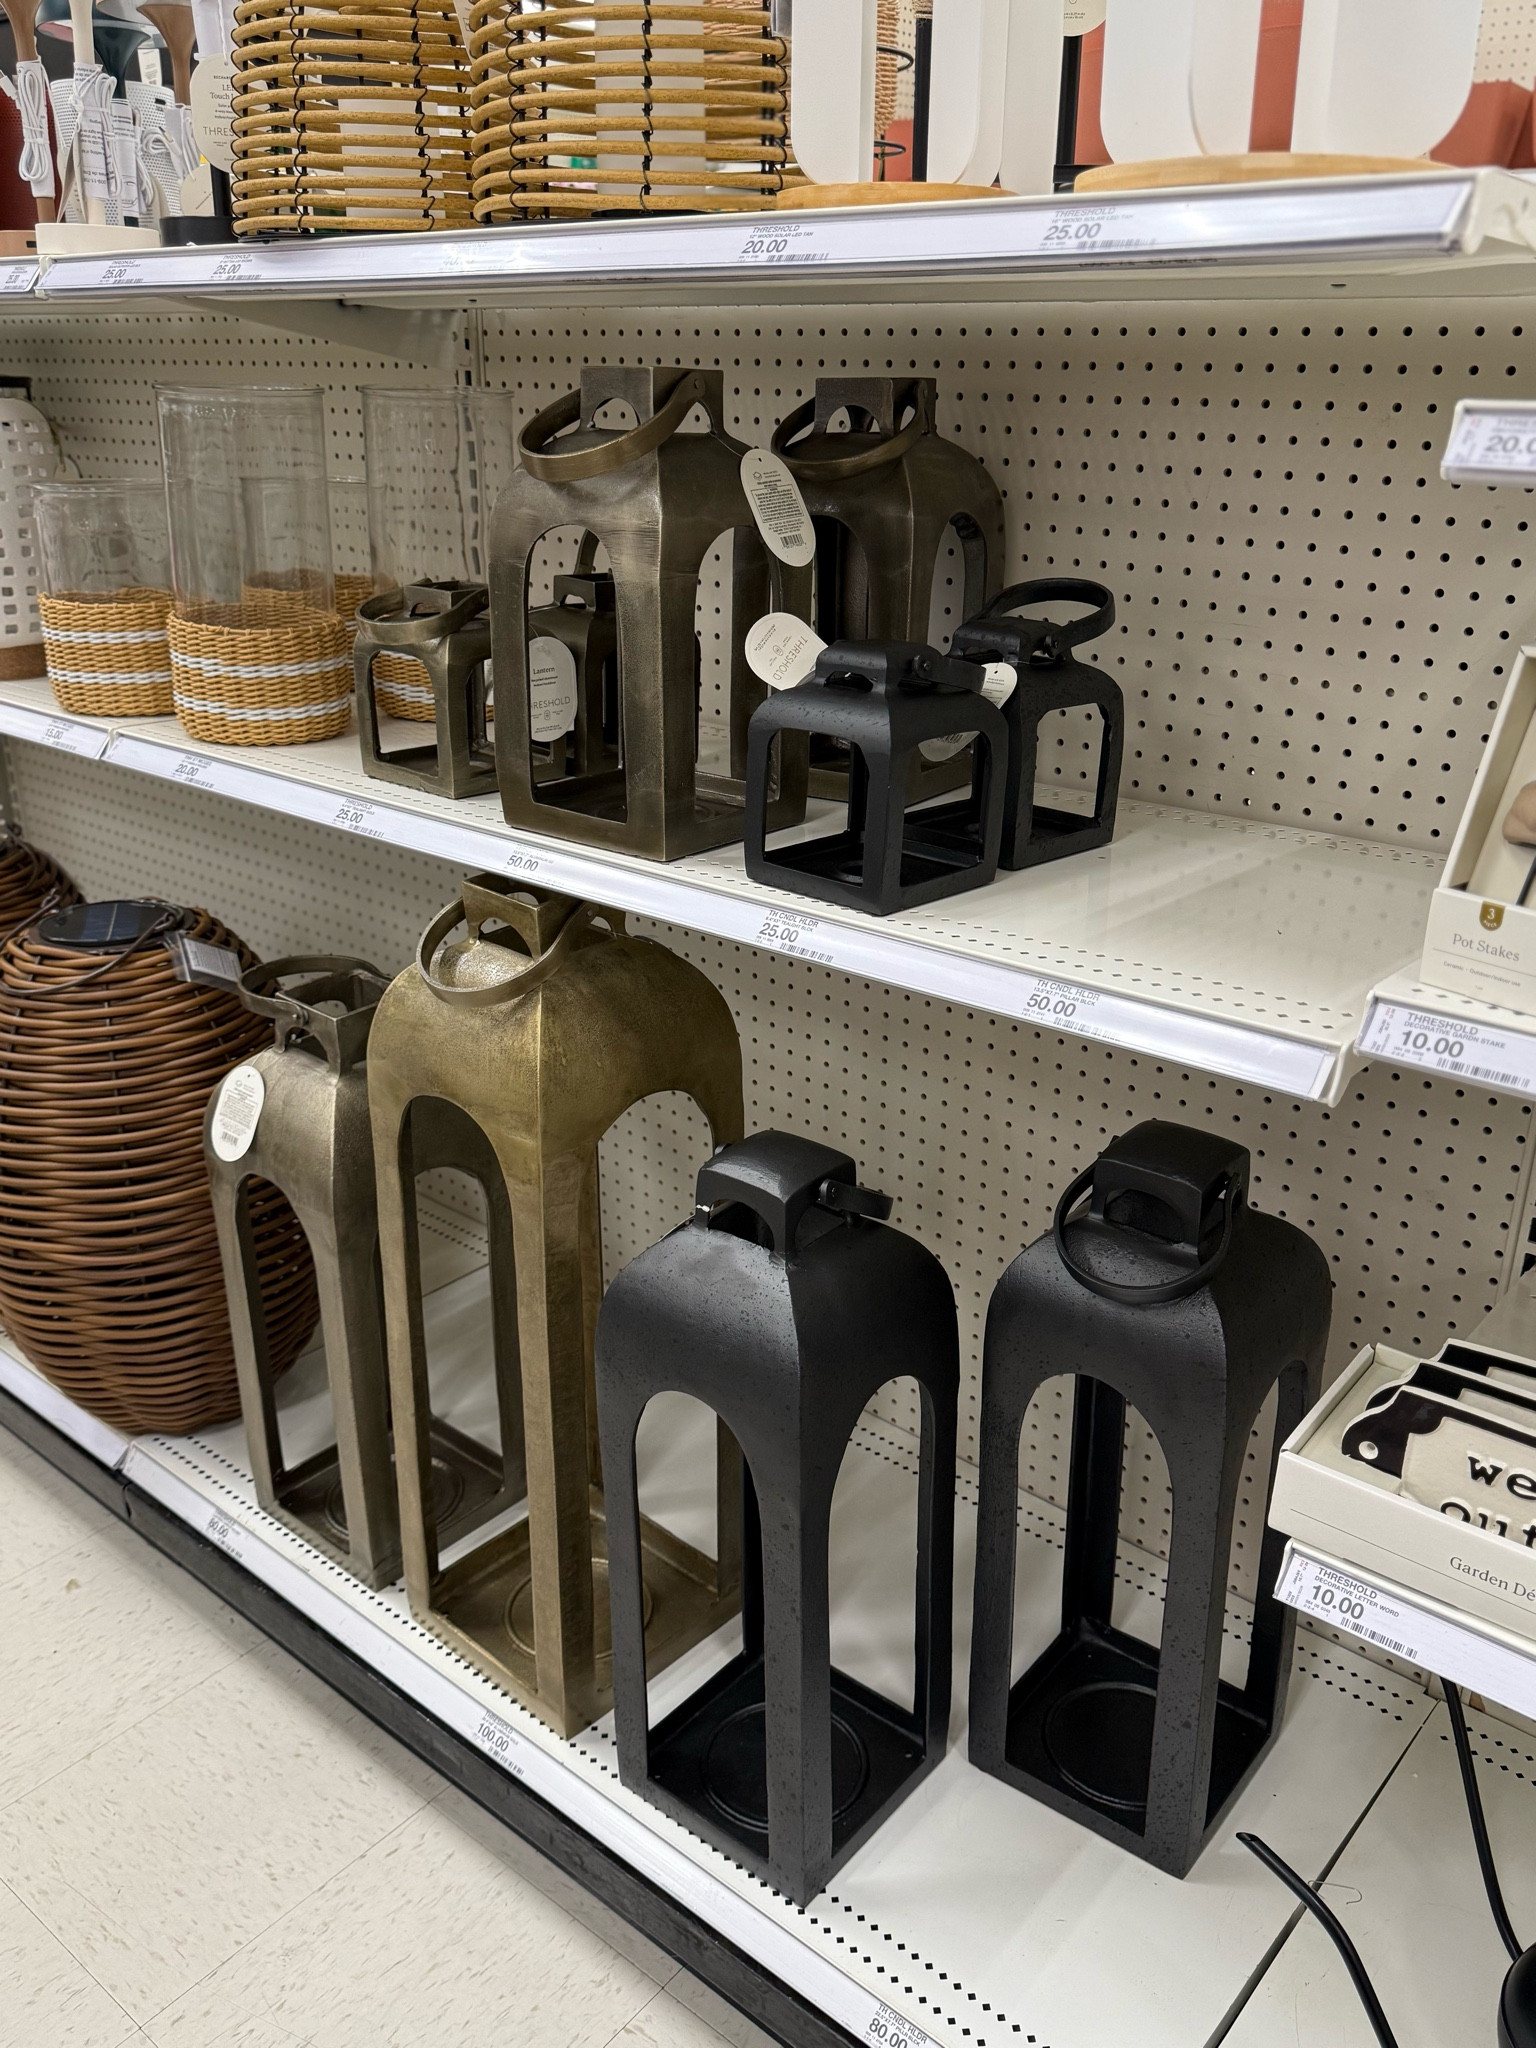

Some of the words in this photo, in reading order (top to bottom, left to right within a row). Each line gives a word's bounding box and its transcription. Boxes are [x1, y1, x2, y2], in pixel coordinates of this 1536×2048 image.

[210, 92, 230, 100] Touch
[203, 126, 234, 136] THRES
[1055, 208, 1116, 218] THRESHOLD
[752, 225, 800, 234] THRESHOLD
[1042, 223, 1102, 240] 25.00
[741, 239, 788, 254] 20.00
[102, 269, 127, 279] 25.00
[212, 264, 242, 274] 25.00
[1484, 434, 1536, 454] 20.0
[772, 636, 808, 680] THRESHOLD
[533, 666, 555, 675] Lantern
[532, 696, 570, 709] RESHOLD
[175, 764, 199, 776] 20.00
[336, 809, 364, 824] 25.00
[507, 855, 539, 872] 50.00
[779, 912, 798, 923] CNDL
[799, 918, 818, 928] HLDR
[1487, 908, 1495, 920] 3
[759, 922, 799, 943] 25.00
[1452, 933, 1474, 949] Pot
[1477, 940, 1520, 961] Stakes
[1444, 960, 1464, 971] Ceramic
[1037, 979, 1049, 988] TH
[1050, 982, 1073, 994] CNDL
[1074, 988, 1101, 1001] HLDR
[1060, 993, 1080, 1003] PILLAR
[1026, 993, 1076, 1017] 50.00
[1407, 1012, 1479, 1036] THRESHOLD
[1404, 1021, 1450, 1036] DECORATIVE
[1452, 1032, 1480, 1042] GARDN
[1481, 1038, 1506, 1049] STAKE
[1401, 1030, 1464, 1058] 10.00
[1318, 1567, 1378, 1599] THRESHOLD
[1450, 1556, 1508, 1591] Garden
[1512, 1582, 1536, 1601] Dé
[1312, 1585, 1364, 1620] 10.00
[1314, 1576, 1354, 1597] DECORATIVE
[1354, 1593, 1379, 1608] LETTER
[1380, 1604, 1400, 1618] WORD
[478, 1723, 509, 1752] 100.00
[878, 2003, 888, 2015] TH
[888, 2011, 906, 2030] CNDL
[908, 2025, 928, 2044] HLDR
[869, 2018, 908, 2048] 80.00
